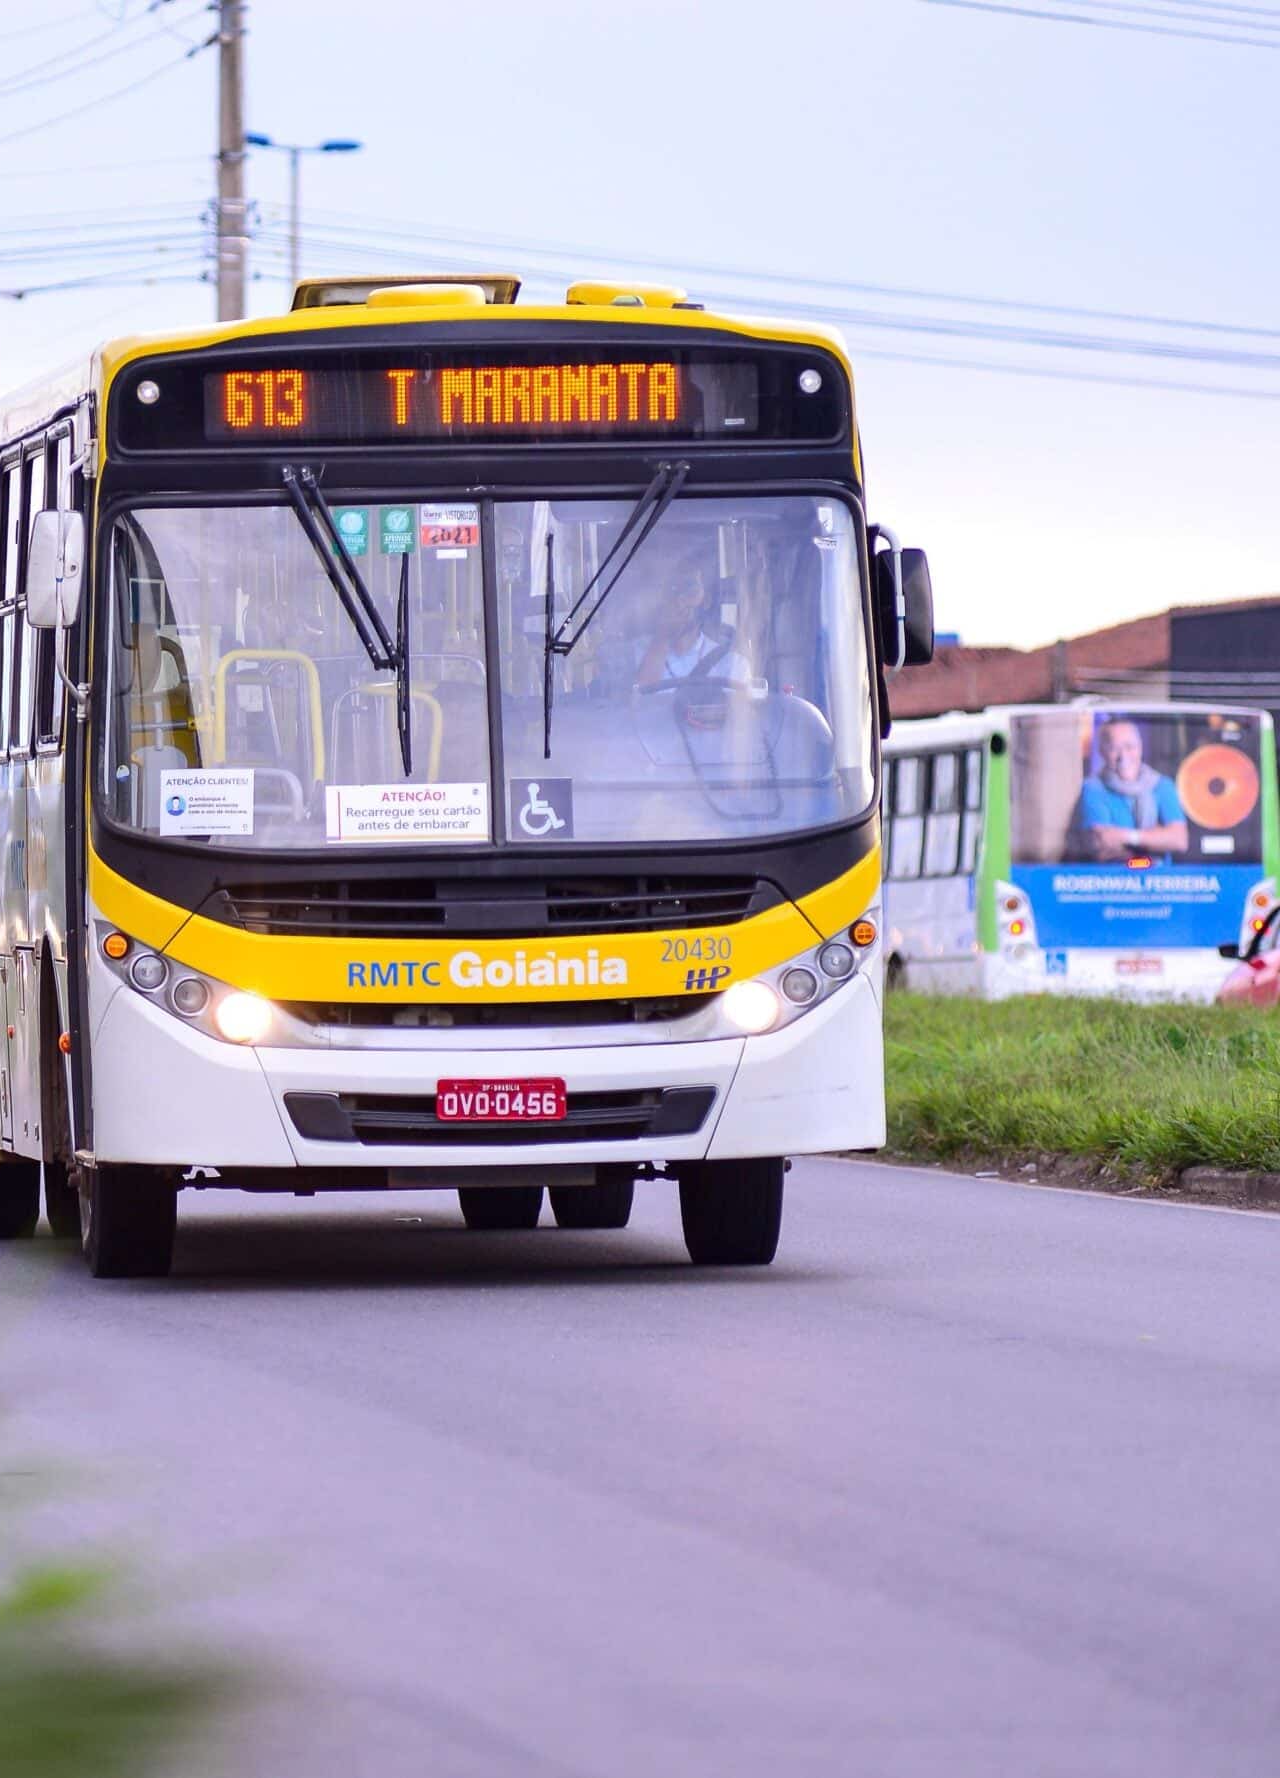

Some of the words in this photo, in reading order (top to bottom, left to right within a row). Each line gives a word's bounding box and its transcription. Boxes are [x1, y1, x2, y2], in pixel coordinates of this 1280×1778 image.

[225, 369, 305, 427] 613
[388, 369, 413, 425] T
[441, 363, 675, 424] MARANATA
[166, 777, 206, 786] ATENÇÃO
[381, 789, 446, 802] ATENÇÃO!
[346, 807, 415, 819] Recarregue
[419, 808, 439, 816] seu
[443, 806, 481, 816] cartão
[358, 821, 390, 830] antes
[393, 820, 410, 830] de
[413, 819, 471, 830] embarcar
[661, 936, 732, 964] 20430
[347, 962, 441, 987] RMTC
[448, 950, 628, 988] Goiânia
